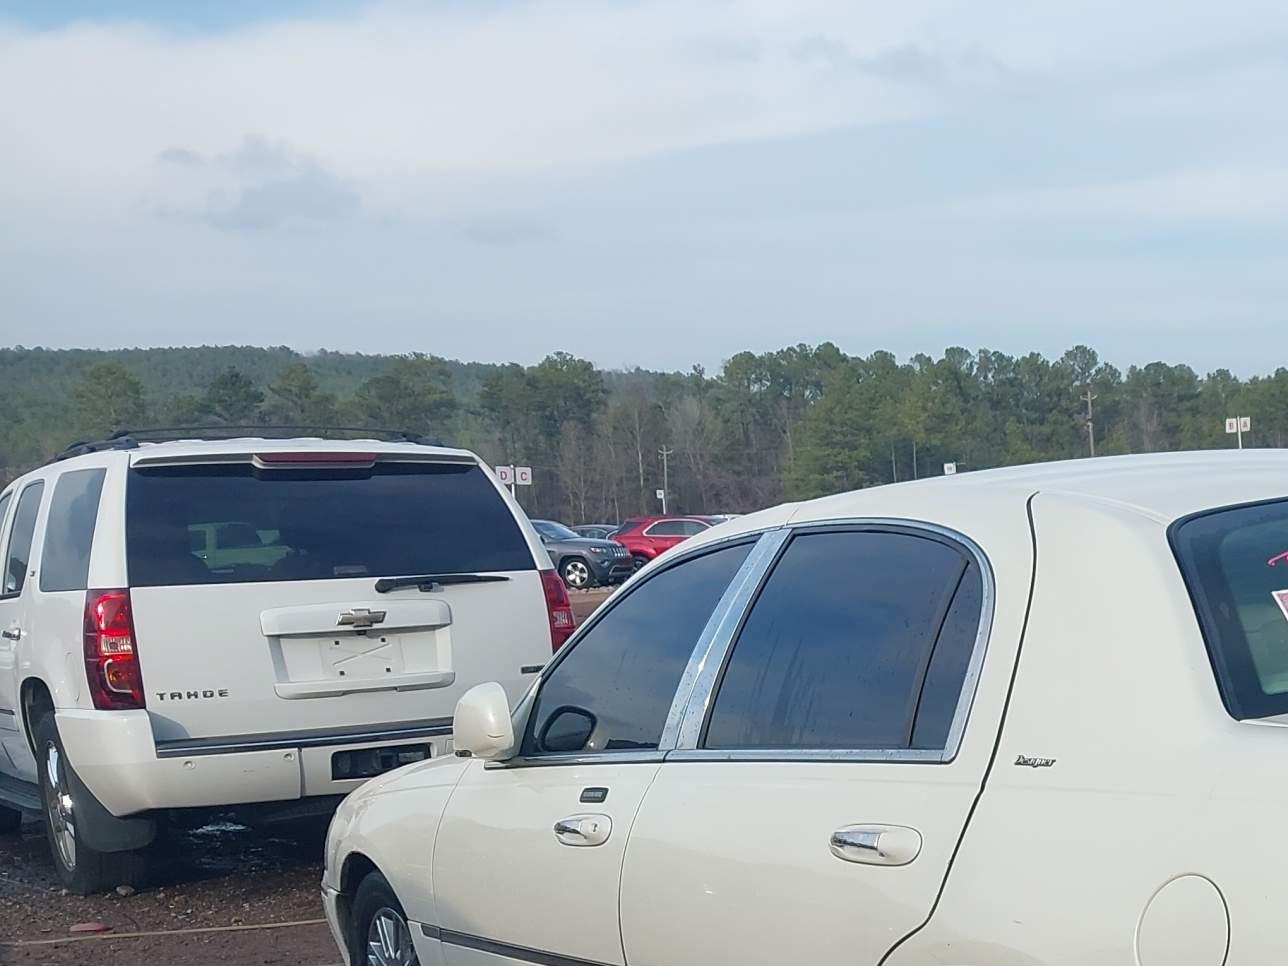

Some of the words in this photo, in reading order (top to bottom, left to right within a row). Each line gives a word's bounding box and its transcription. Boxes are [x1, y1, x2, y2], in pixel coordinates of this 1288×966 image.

[500, 471, 508, 481] D
[520, 471, 528, 481] C
[155, 688, 230, 701] TAHOE
